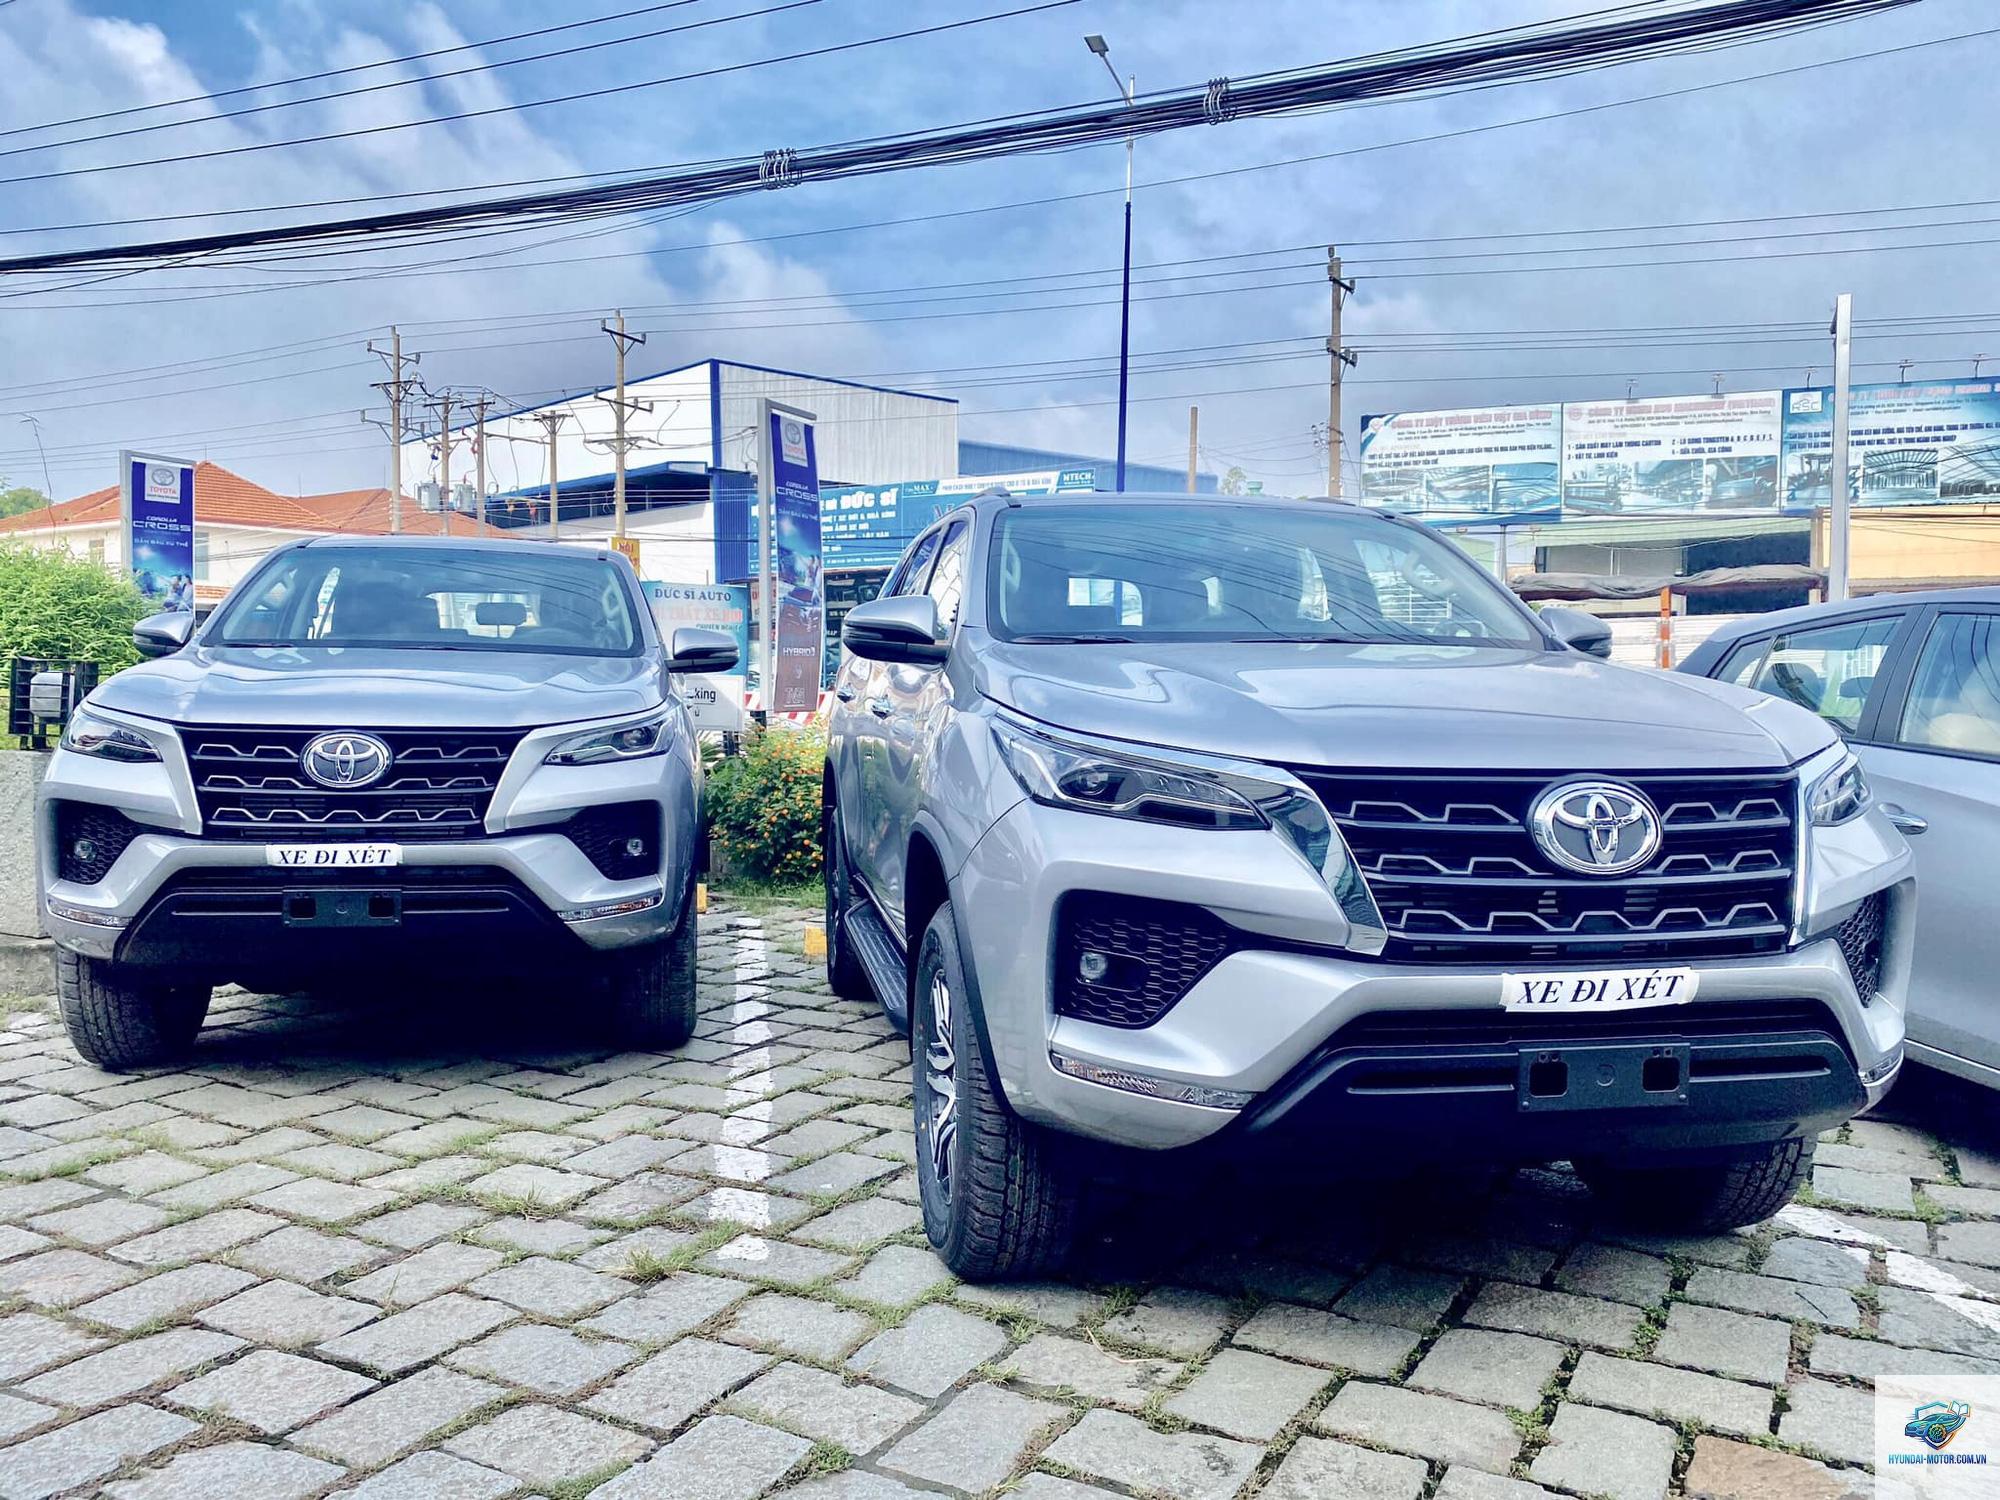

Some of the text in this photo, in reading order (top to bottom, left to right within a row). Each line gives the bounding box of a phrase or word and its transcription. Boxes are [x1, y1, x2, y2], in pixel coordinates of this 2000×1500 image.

[150, 486, 176, 494] TOYOTA
[776, 486, 818, 502] CROSS
[133, 520, 191, 532] CROSS
[698, 590, 732, 602] AUTO
[782, 647, 811, 657] HYBRID
[694, 688, 716, 703] king
[279, 845, 392, 865] XE ĐI XÉT
[1516, 970, 1684, 1005] XE ĐI XÉT
